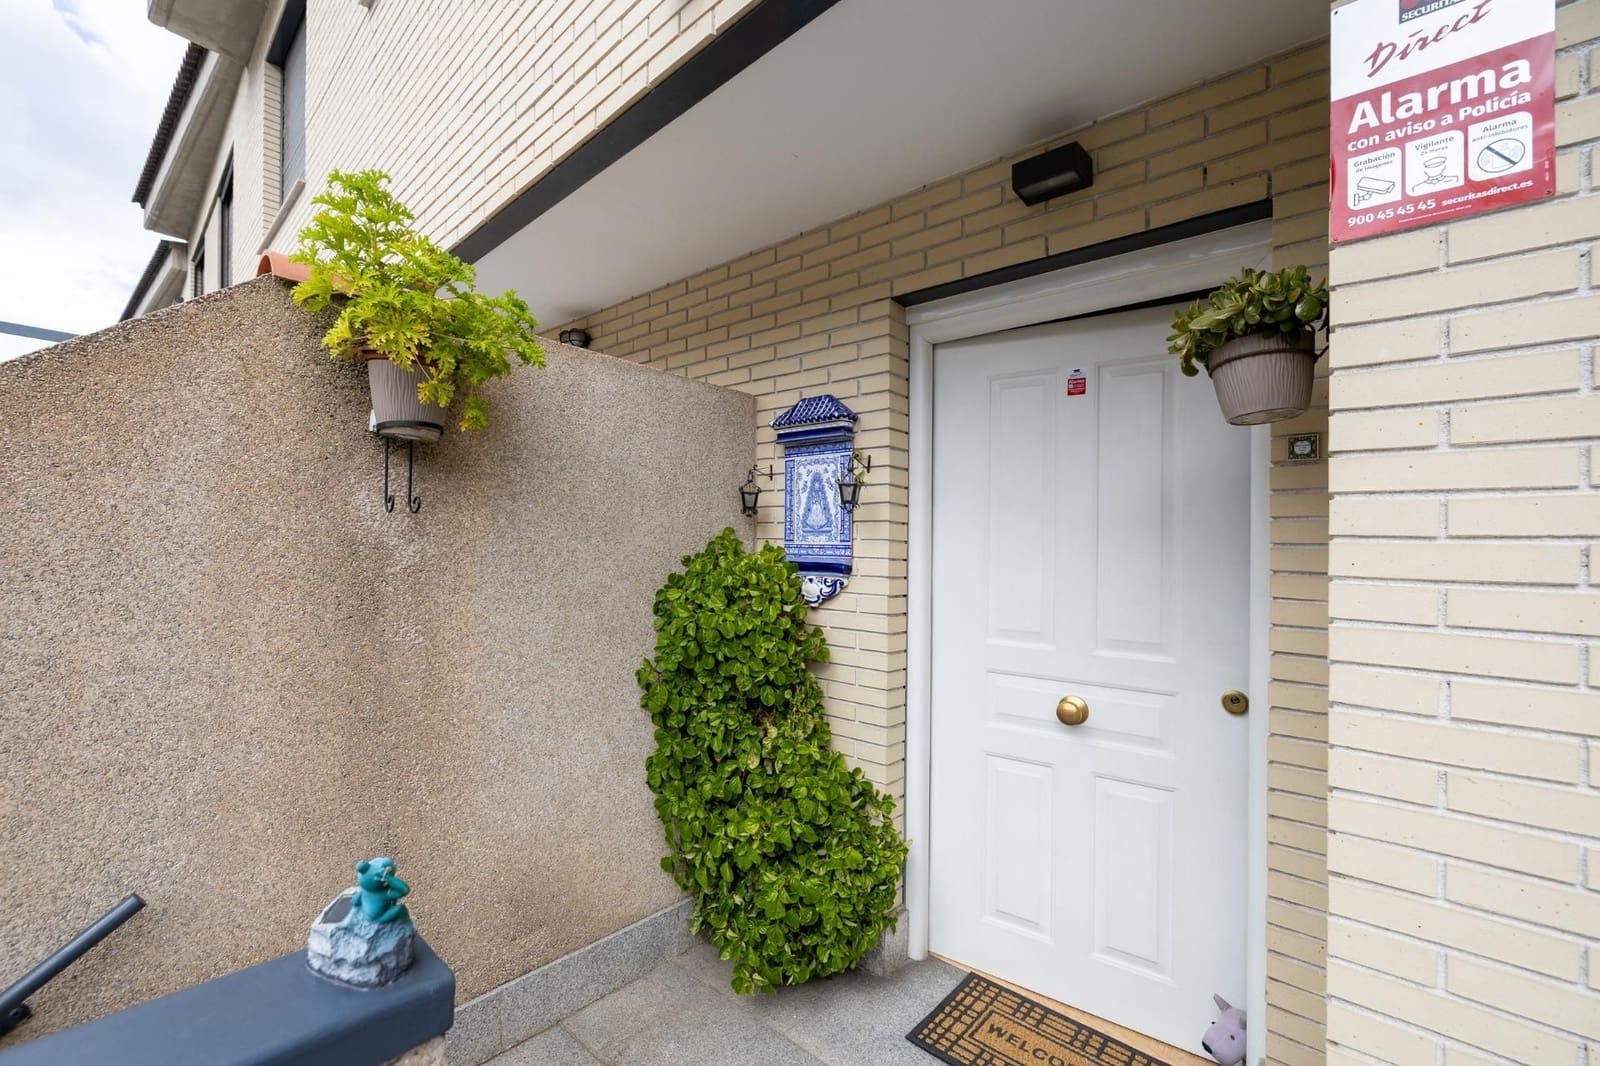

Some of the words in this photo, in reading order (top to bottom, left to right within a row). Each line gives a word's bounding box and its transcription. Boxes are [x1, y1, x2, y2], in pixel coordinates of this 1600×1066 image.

[1401, 0, 1459, 21] SECURIT
[1362, 0, 1493, 77] Direct
[1347, 58, 1532, 135] Alarma
[1347, 134, 1380, 151] con
[1384, 121, 1436, 142] aviso
[1440, 114, 1453, 126] a
[1459, 90, 1532, 121] Policía
[1482, 119, 1518, 133] Alarma
[1353, 152, 1396, 168] Grabación
[1414, 136, 1455, 151] Vigilante
[1347, 213, 1374, 227] 900
[1376, 207, 1394, 220] 45
[1397, 203, 1415, 215] 45
[1417, 199, 1436, 210] 45
[1441, 180, 1534, 207] securitasdirect.es
[988, 1023, 1075, 1066] WELCO
